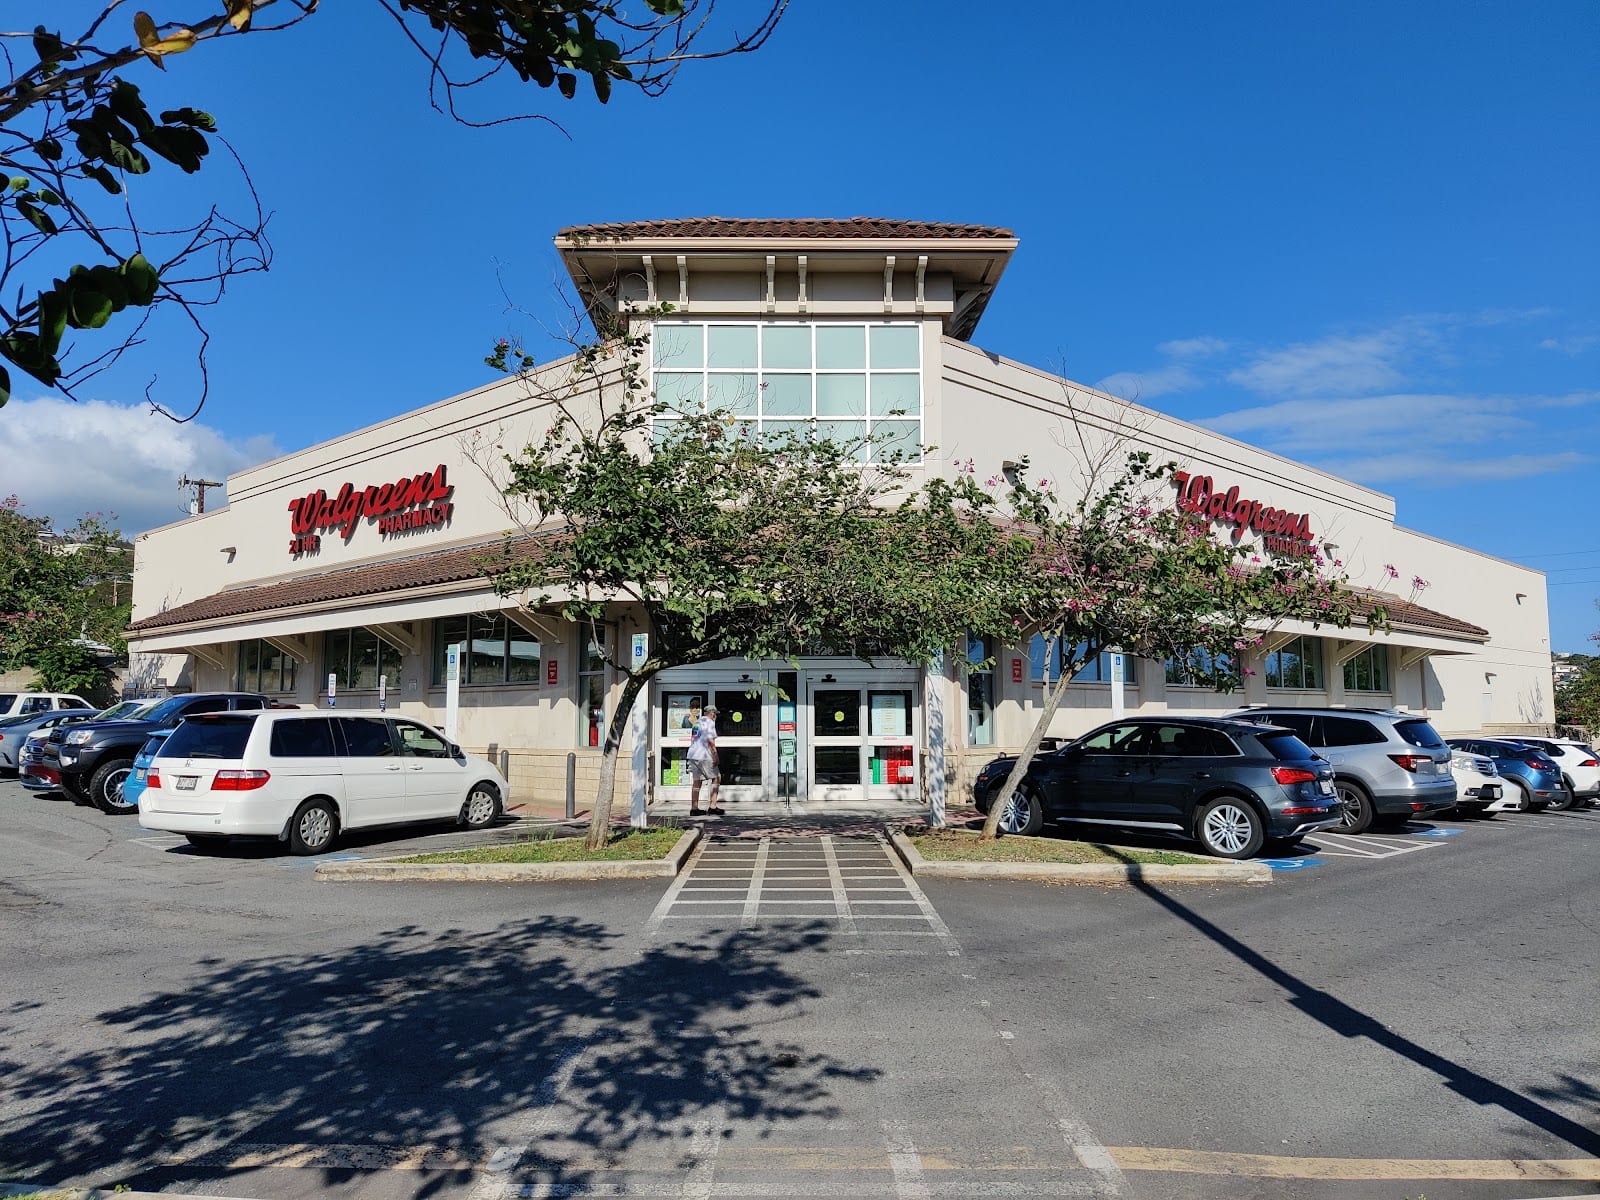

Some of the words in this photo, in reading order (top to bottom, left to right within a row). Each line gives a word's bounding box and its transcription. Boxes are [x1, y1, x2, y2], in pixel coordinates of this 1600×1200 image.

[288, 464, 452, 539] Walgreens
[378, 503, 452, 535] PHARMACY
[1175, 471, 1314, 541] Walgreens
[288, 539, 301, 554] 24
[302, 534, 318, 552] HR
